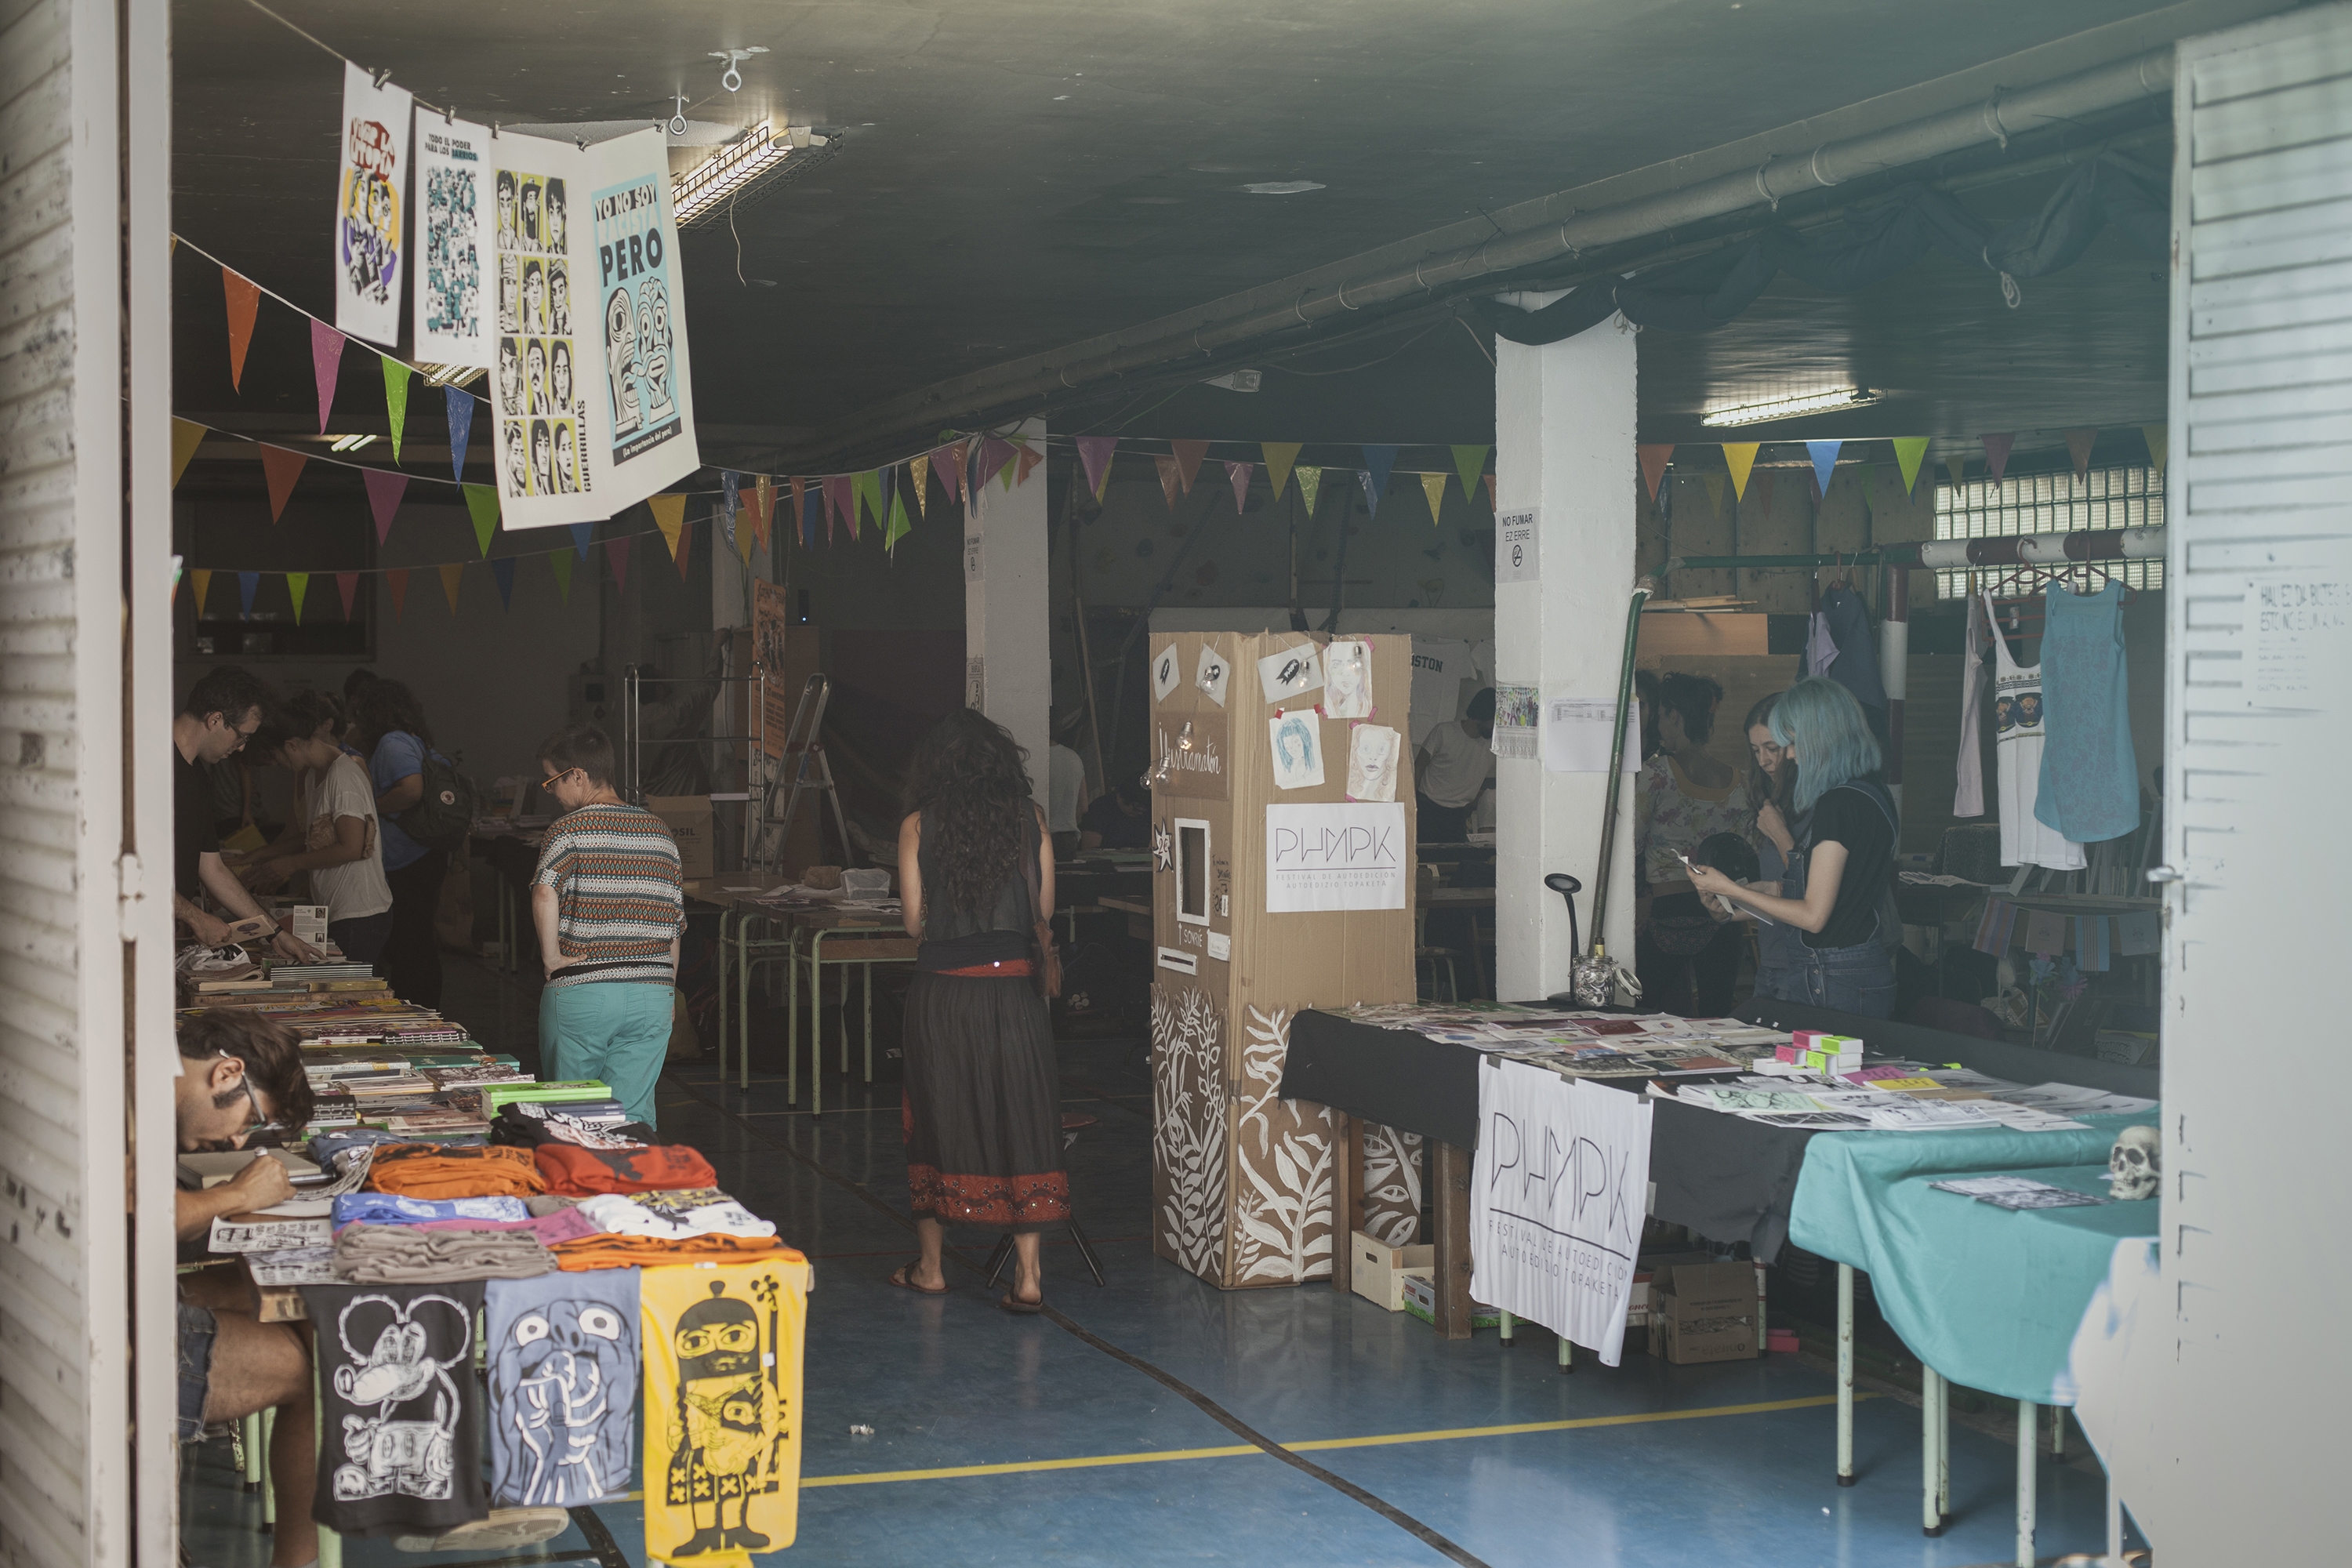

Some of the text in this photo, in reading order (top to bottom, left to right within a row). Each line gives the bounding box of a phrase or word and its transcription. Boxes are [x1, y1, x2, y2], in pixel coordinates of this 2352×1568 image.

[425, 142, 478, 162] PARA LOS BARRIOS
[429, 133, 471, 151] TODO EL PODER
[594, 183, 657, 222] YO NO SOY
[600, 227, 663, 288] PERO
[577, 400, 592, 492] GUERRILLAS
[1503, 514, 1533, 527] NO FUMAR
[1505, 529, 1530, 542] EZ ERRE
[1158, 838, 1169, 855] 2€
[1184, 928, 1203, 948] SONRÍE
[1490, 1220, 1537, 1247] FESTIVAL
[1543, 1238, 1552, 1254] DE
[1501, 1244, 1619, 1301] AUTOEDIZIO TOPAKETA
